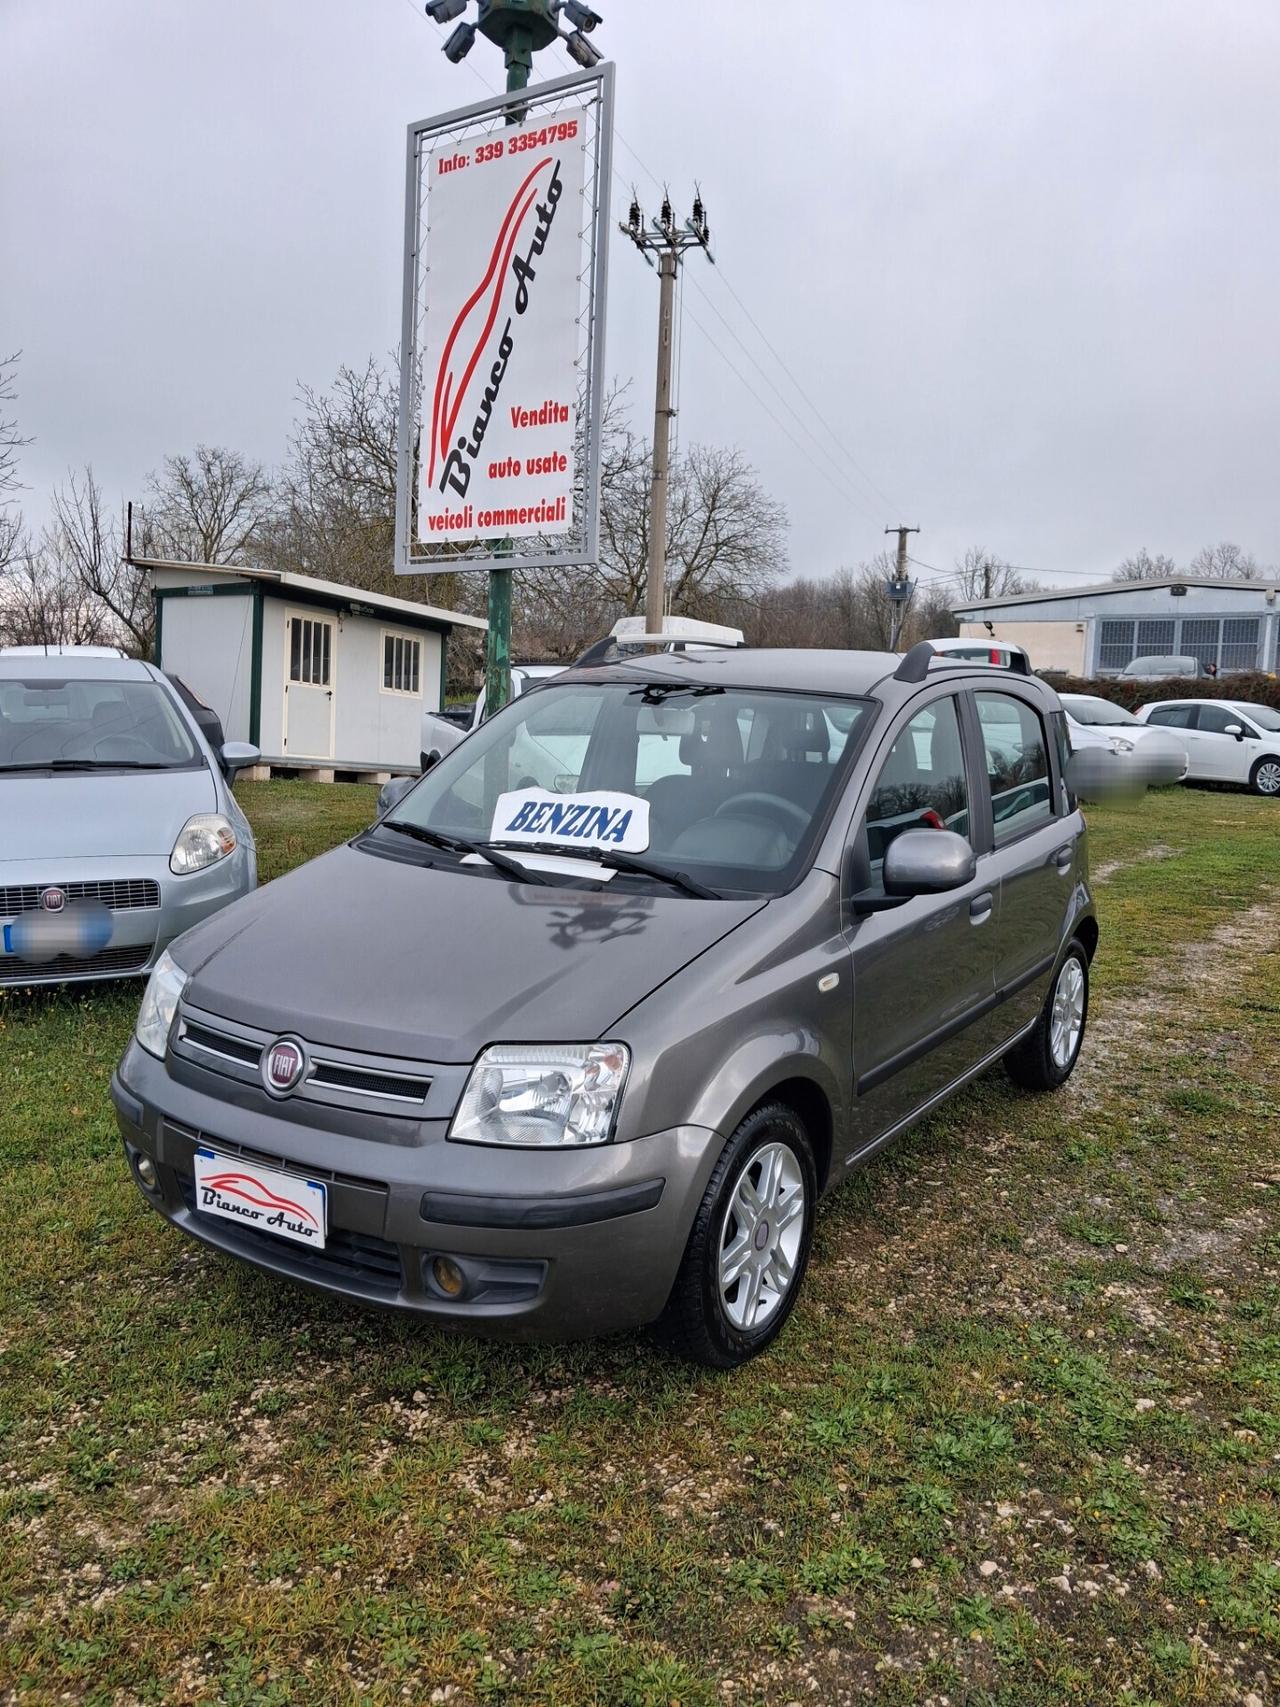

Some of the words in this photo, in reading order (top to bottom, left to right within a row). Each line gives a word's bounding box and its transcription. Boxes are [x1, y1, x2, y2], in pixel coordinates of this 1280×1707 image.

[438, 153, 471, 175] Info:
[475, 141, 504, 165] 339
[508, 120, 578, 155] 3354795
[439, 317, 514, 499] Bianco
[511, 159, 563, 315] Auto
[511, 399, 569, 429] Vendita
[488, 456, 521, 479] auto
[526, 451, 568, 475] usate
[428, 505, 473, 531] veicoli
[477, 496, 566, 528] commerciali
[505, 801, 633, 843] BENZINA
[273, 1054, 296, 1078] FIAT
[201, 1186, 264, 1220] Bianco
[266, 1212, 319, 1237] Auto
